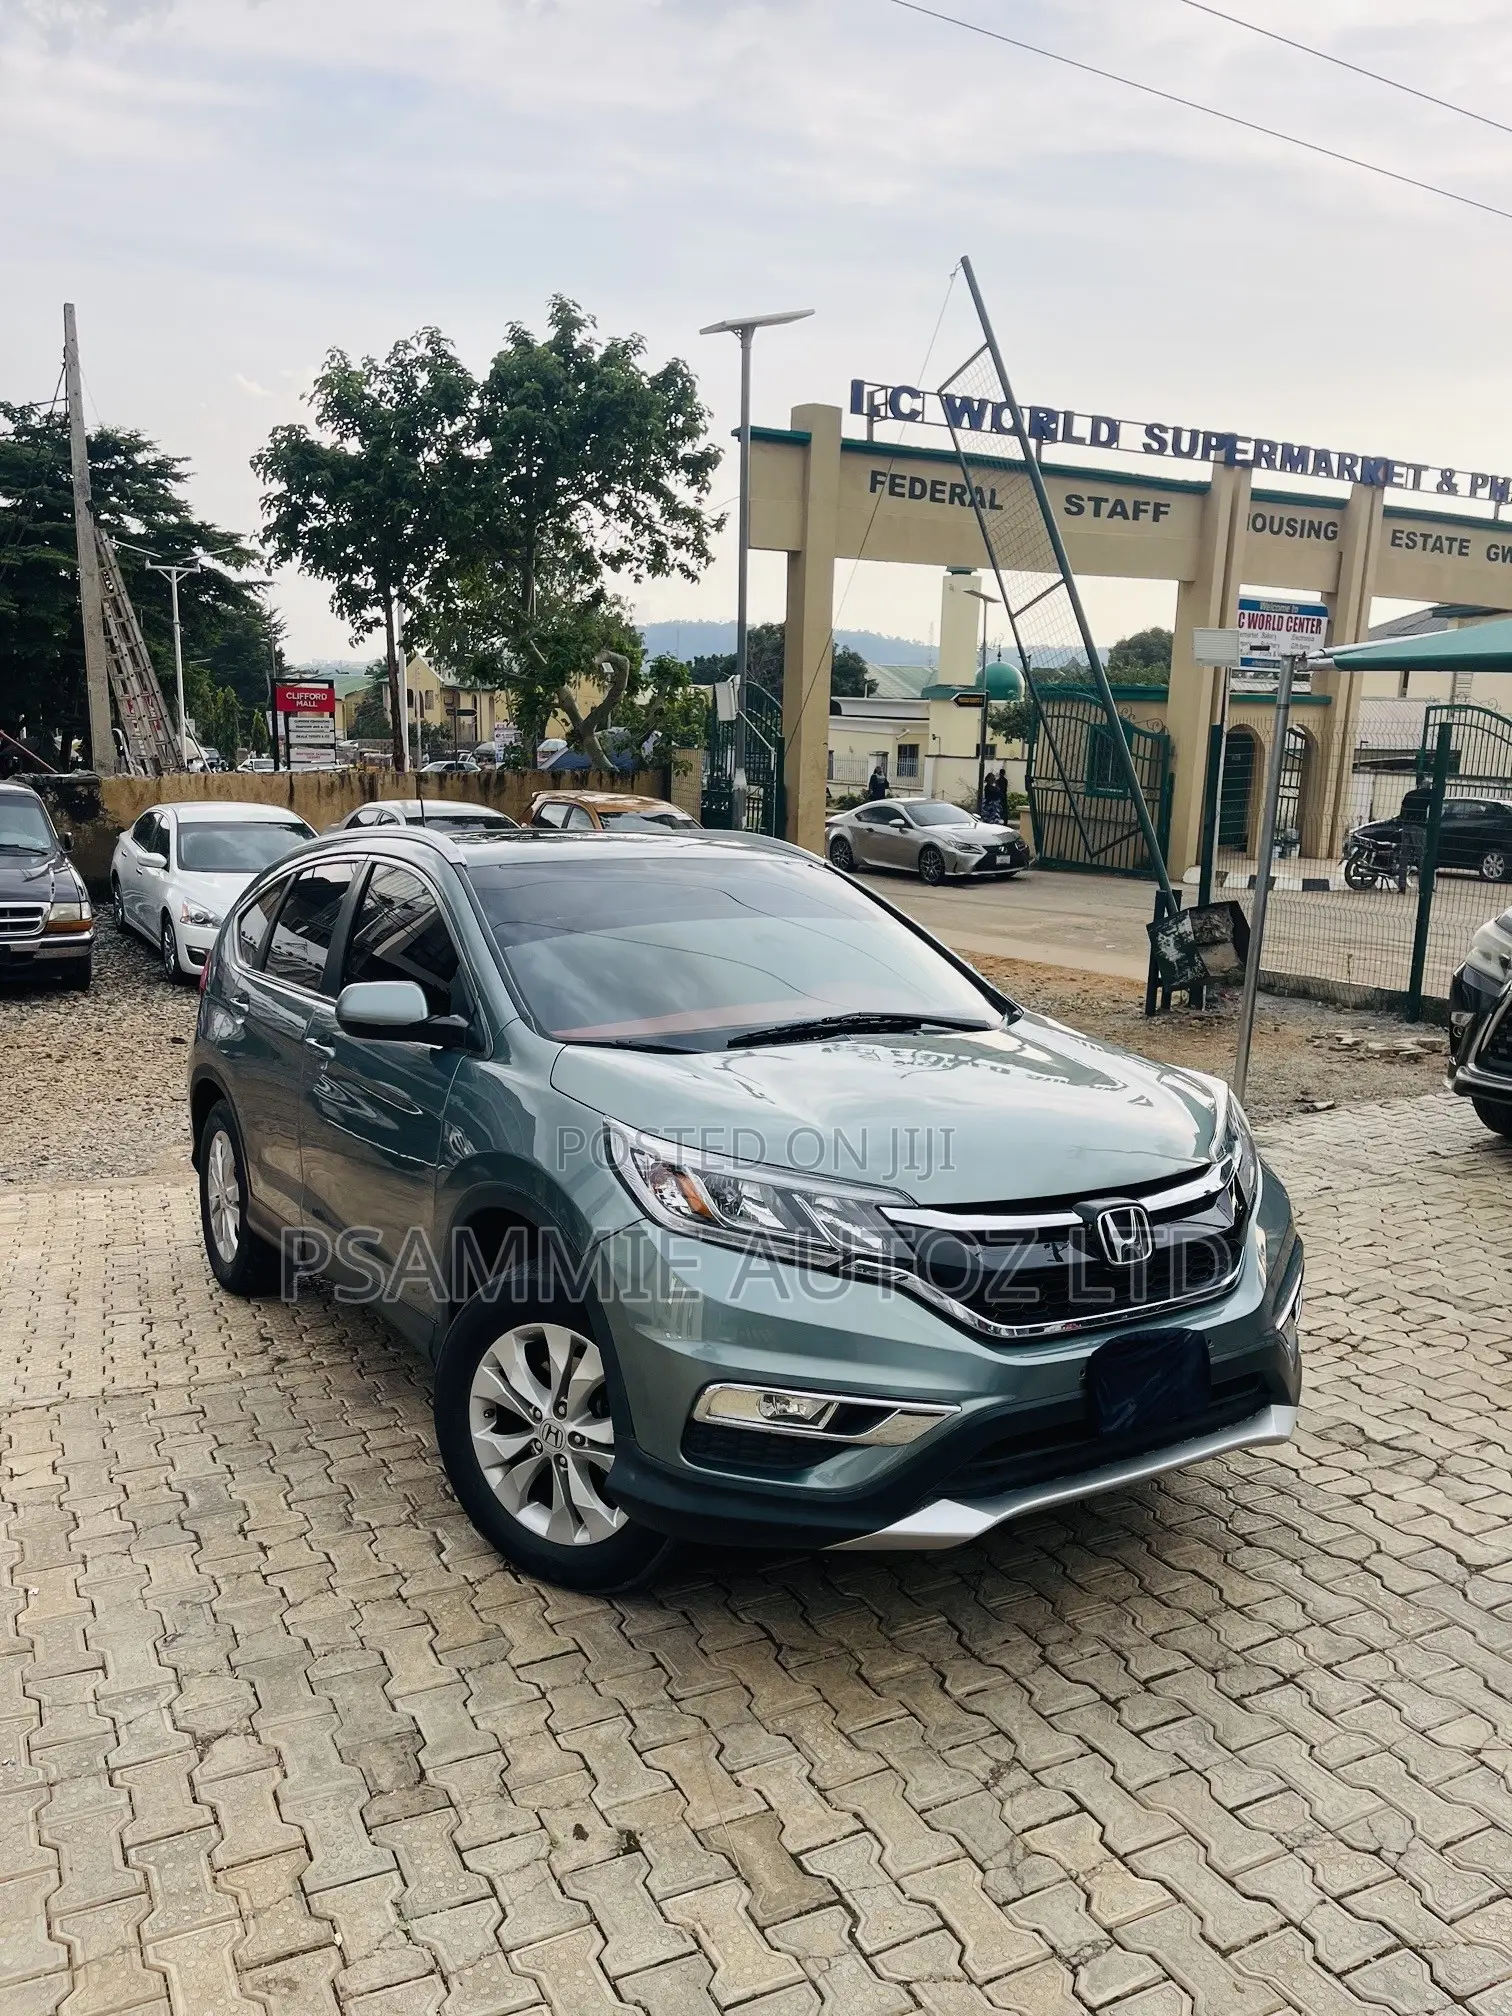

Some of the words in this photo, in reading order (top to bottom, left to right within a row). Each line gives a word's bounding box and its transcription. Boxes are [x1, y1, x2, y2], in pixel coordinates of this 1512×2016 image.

[942, 393, 1118, 448] WORLD
[1143, 423, 1428, 490] SUPERMARKET
[1437, 467, 1459, 495] &
[869, 469, 1003, 511] FEDERAL
[1064, 494, 1171, 522] STAFF
[1390, 528, 1471, 557] ESTATE
[1260, 602, 1289, 612] Welcome
[1291, 604, 1299, 613] to
[1247, 613, 1284, 632] WORLD
[1286, 615, 1322, 635] CENTER
[286, 692, 328, 701] CLIFFORD
